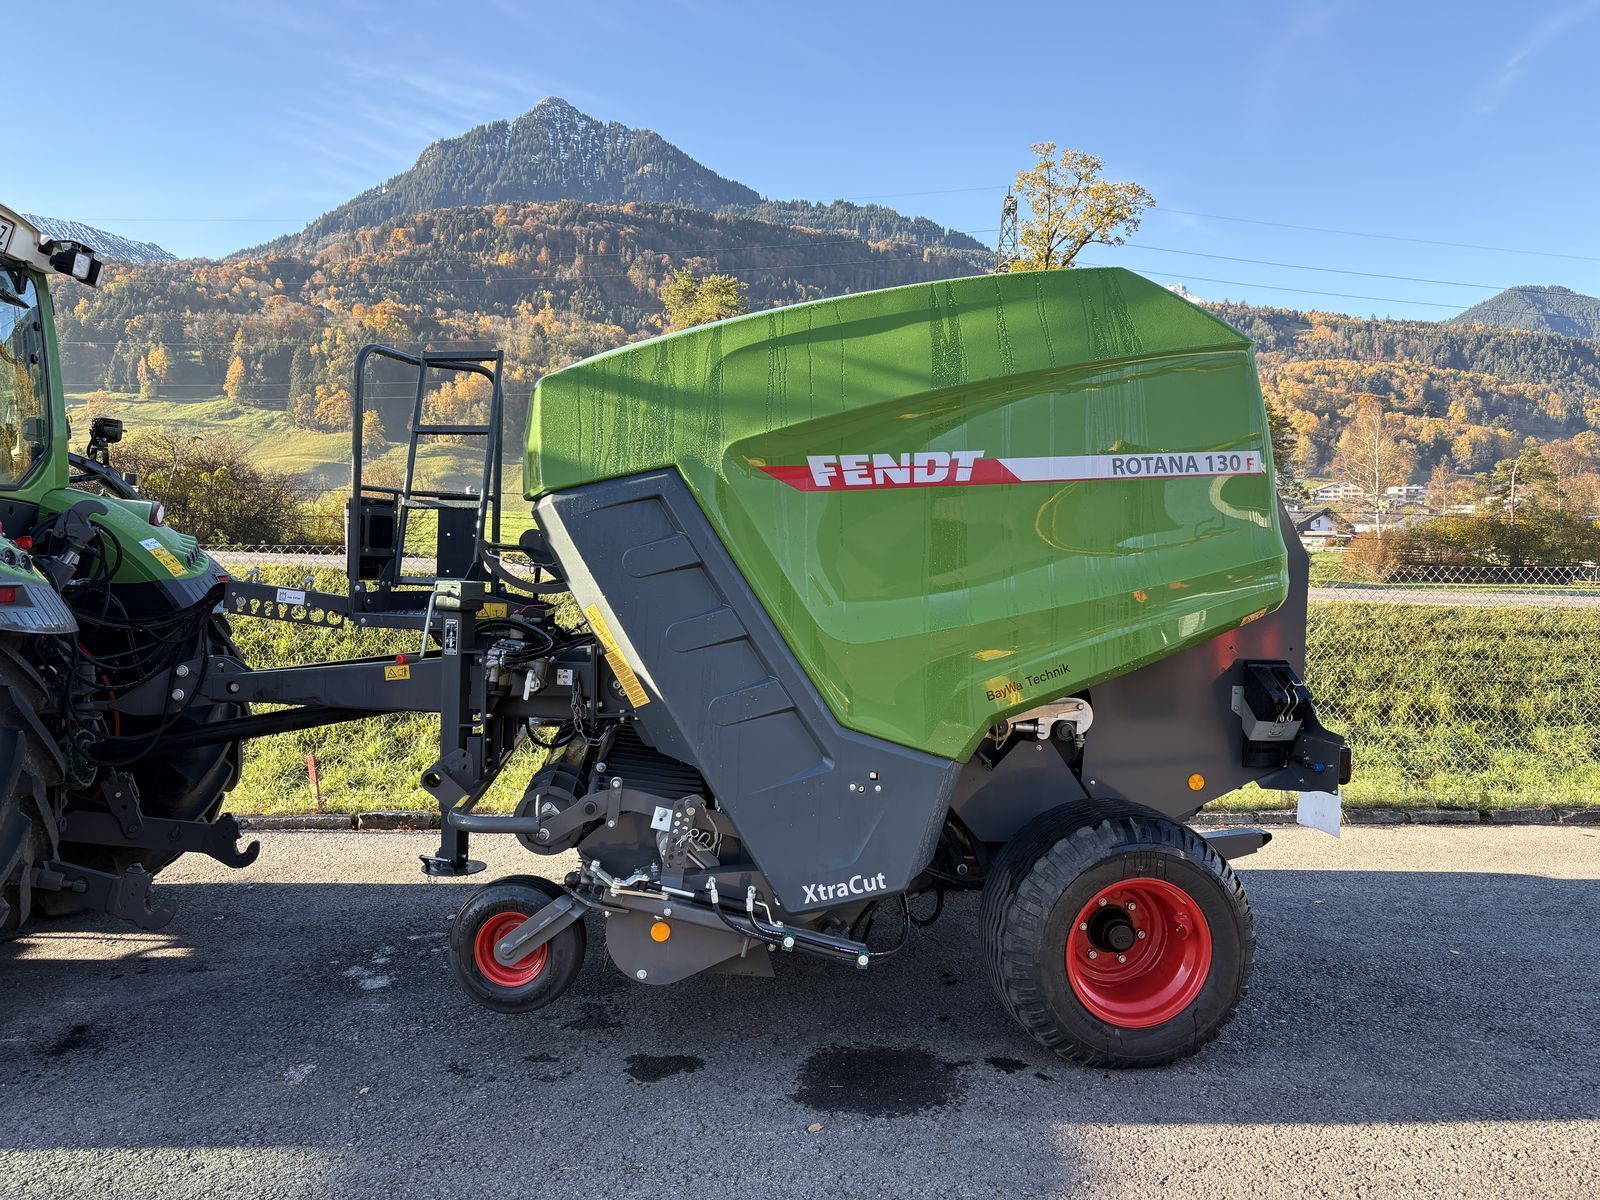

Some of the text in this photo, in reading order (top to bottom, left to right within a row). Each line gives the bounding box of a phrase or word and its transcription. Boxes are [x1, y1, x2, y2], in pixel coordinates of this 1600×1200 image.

[806, 450, 984, 487] FENDT
[1112, 454, 1255, 475] ROTANA 130 F
[986, 663, 1071, 702] BayWa Technik
[802, 872, 887, 904] XtraCut
